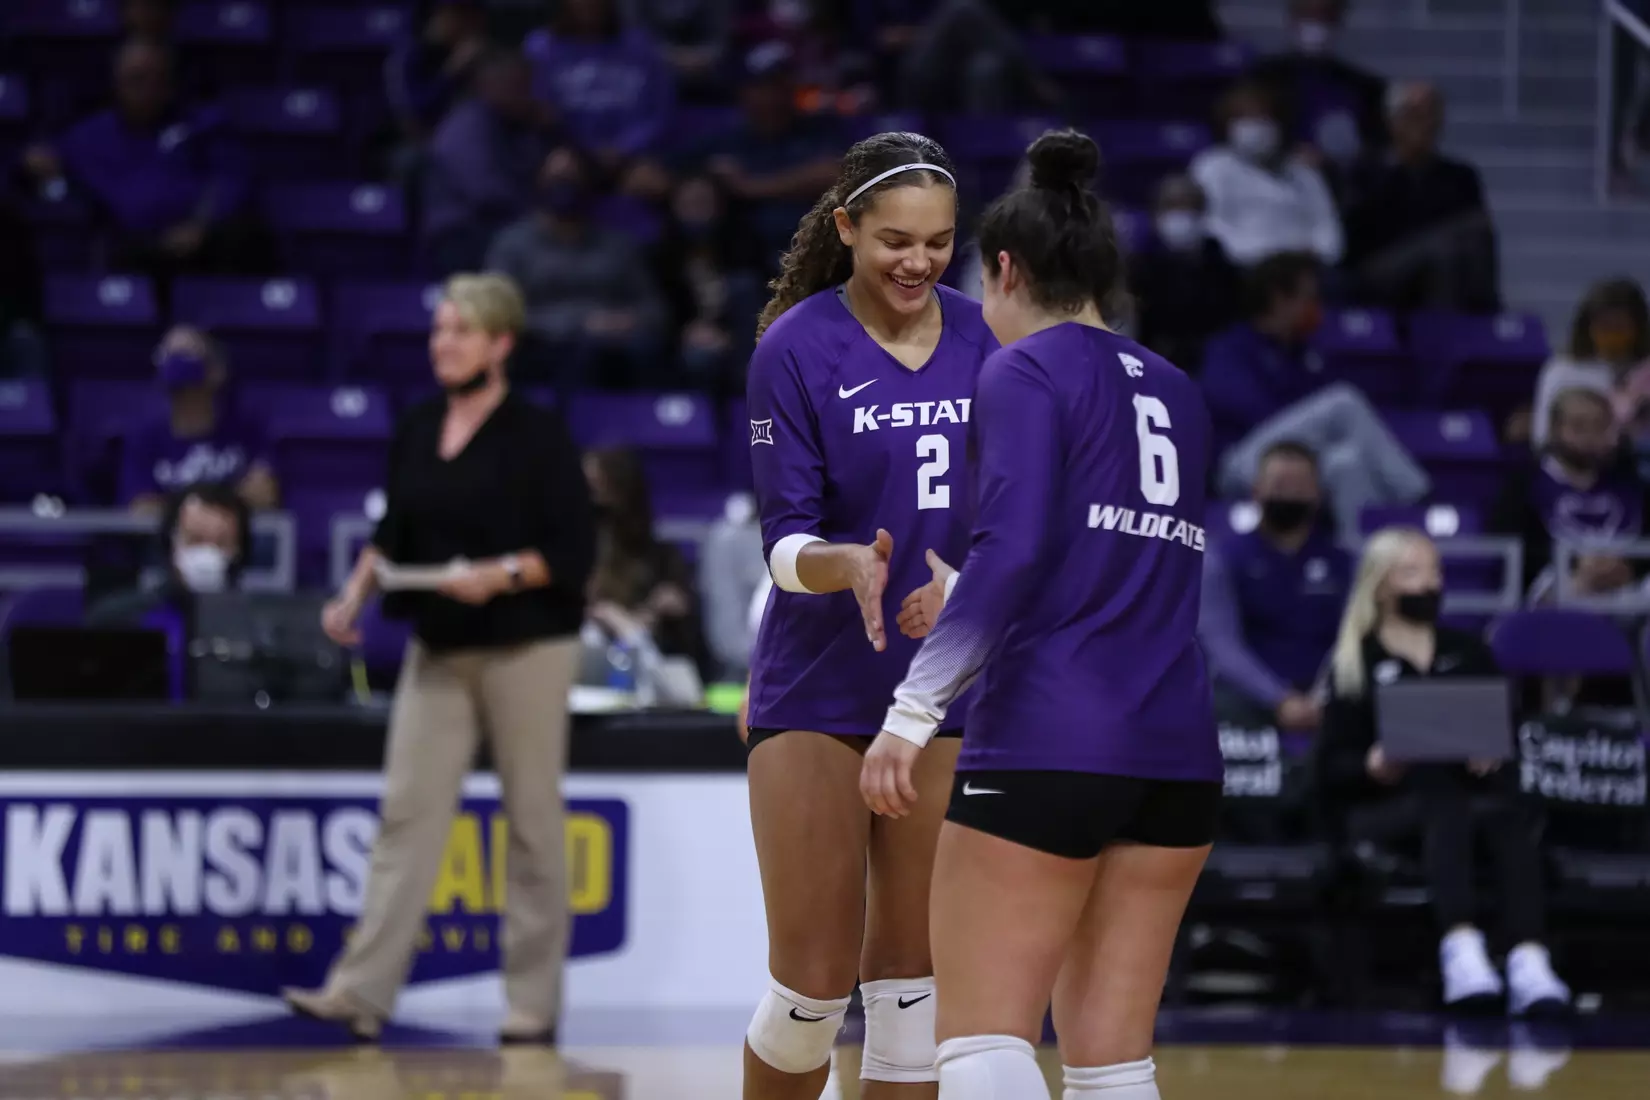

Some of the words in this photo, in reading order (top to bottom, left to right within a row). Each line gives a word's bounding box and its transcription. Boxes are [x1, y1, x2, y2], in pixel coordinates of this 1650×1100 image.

[853, 398, 972, 433] K-STAT
[916, 434, 950, 510] 2
[1132, 393, 1180, 507] 6
[1087, 503, 1206, 552] WILDCATS
[5, 803, 613, 917] KANSASAD
[65, 922, 183, 955] TIRE
[215, 923, 315, 955] AND
